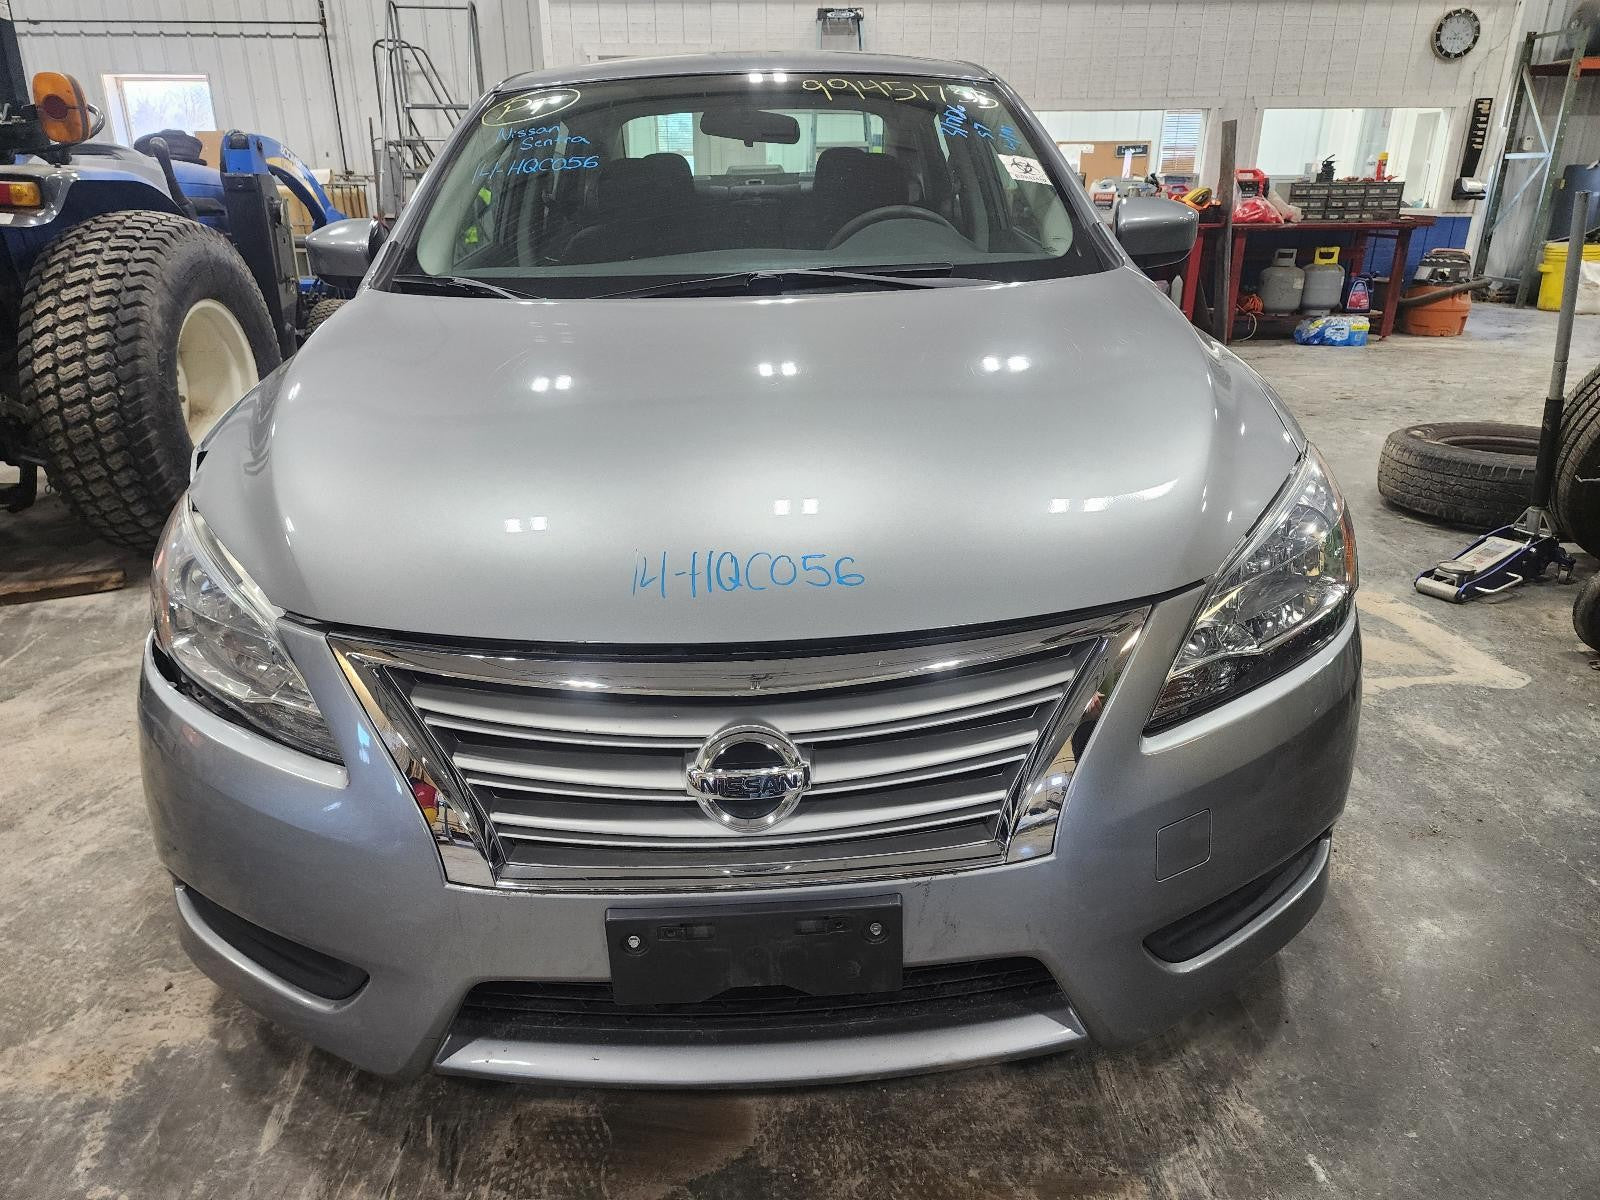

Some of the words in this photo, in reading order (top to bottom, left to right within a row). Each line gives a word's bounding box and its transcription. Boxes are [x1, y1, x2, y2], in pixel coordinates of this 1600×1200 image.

[496, 124, 561, 144] Nissan
[519, 134, 592, 151] Sentra
[631, 548, 866, 599] 14-HQC056
[700, 773, 800, 797] NISSAN
